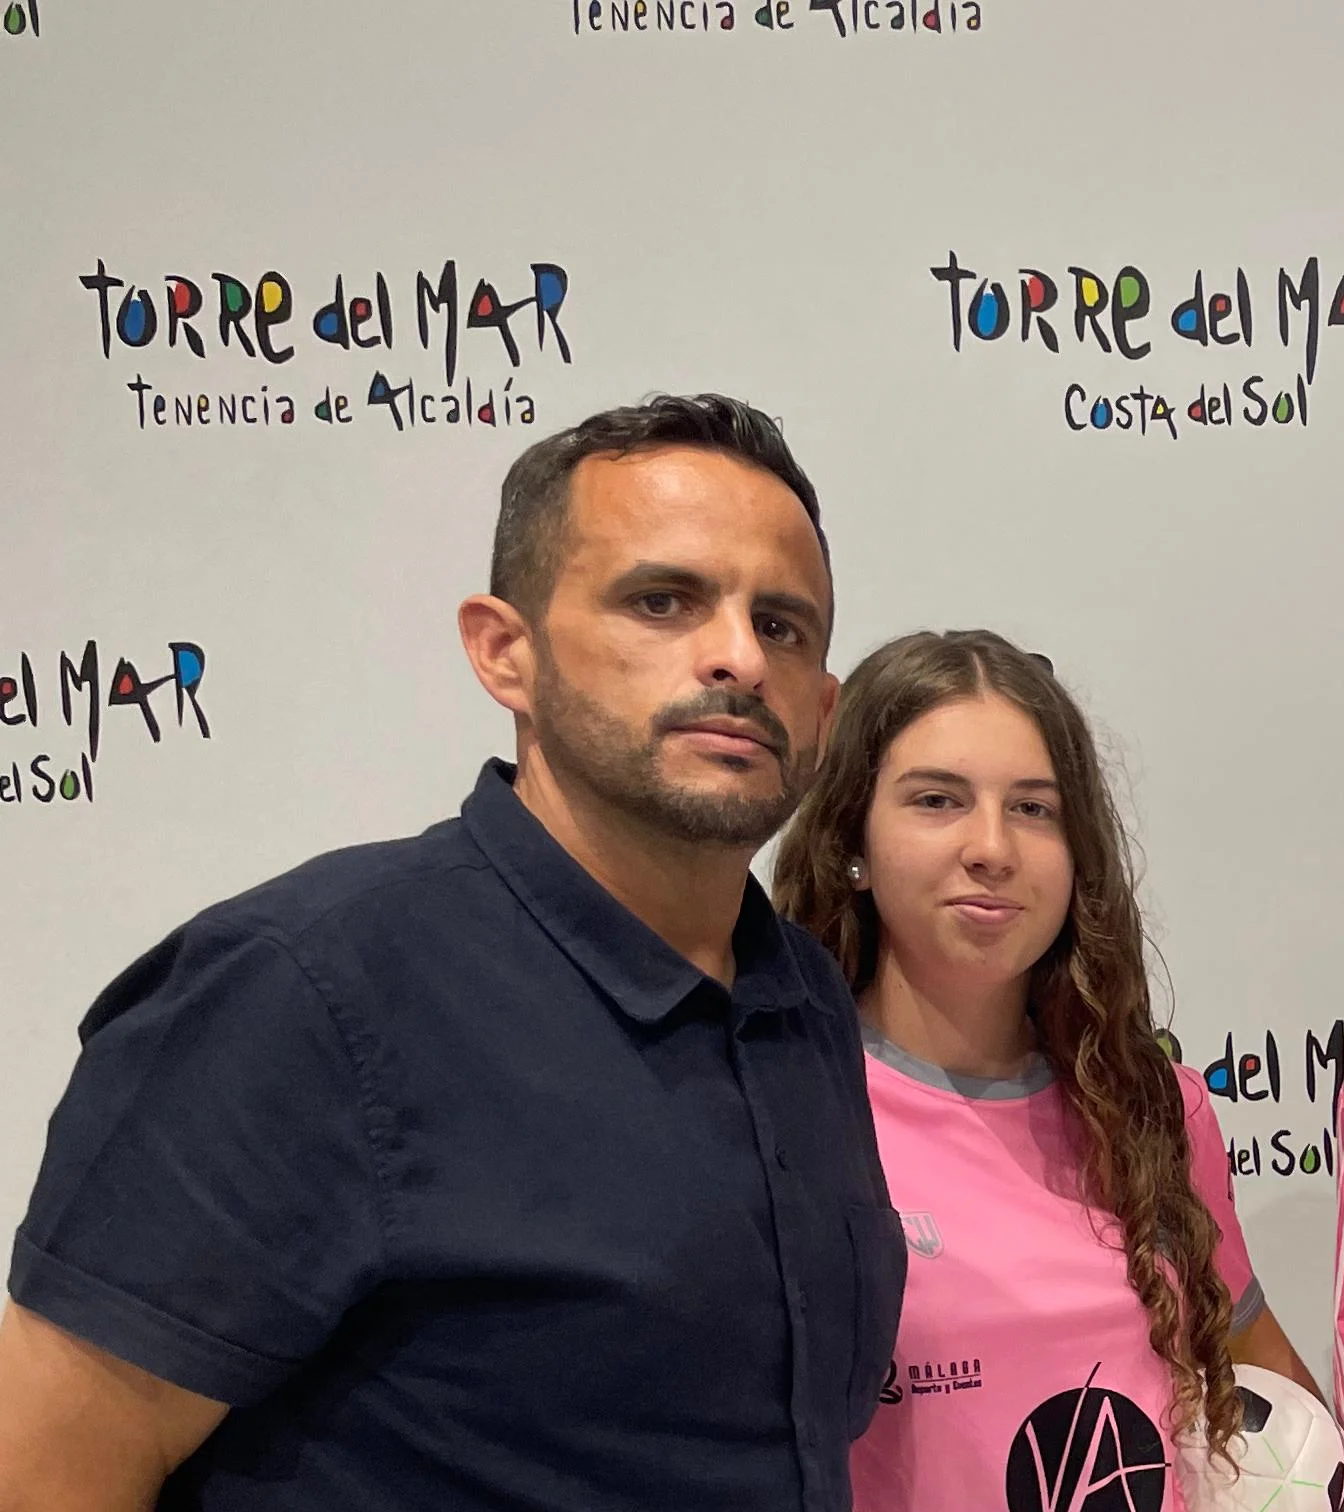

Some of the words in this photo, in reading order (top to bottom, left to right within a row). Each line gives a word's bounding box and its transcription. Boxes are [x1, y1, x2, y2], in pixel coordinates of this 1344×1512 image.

[755, 0, 795, 31] de
[313, 271, 394, 350] del
[416, 260, 573, 388] MAR
[1171, 270, 1253, 347] del
[128, 373, 296, 430] Tenencia
[314, 383, 354, 425] de
[367, 371, 536, 431] Alcaldía
[1065, 382, 1178, 440] Costa
[1189, 391, 1233, 428] del
[1243, 373, 1308, 428] Sol
[0, 650, 37, 727] el
[60, 640, 211, 762] MAR
[30, 752, 97, 803] Sol
[1204, 1032, 1280, 1103] del
[1270, 1128, 1333, 1177] Sol
